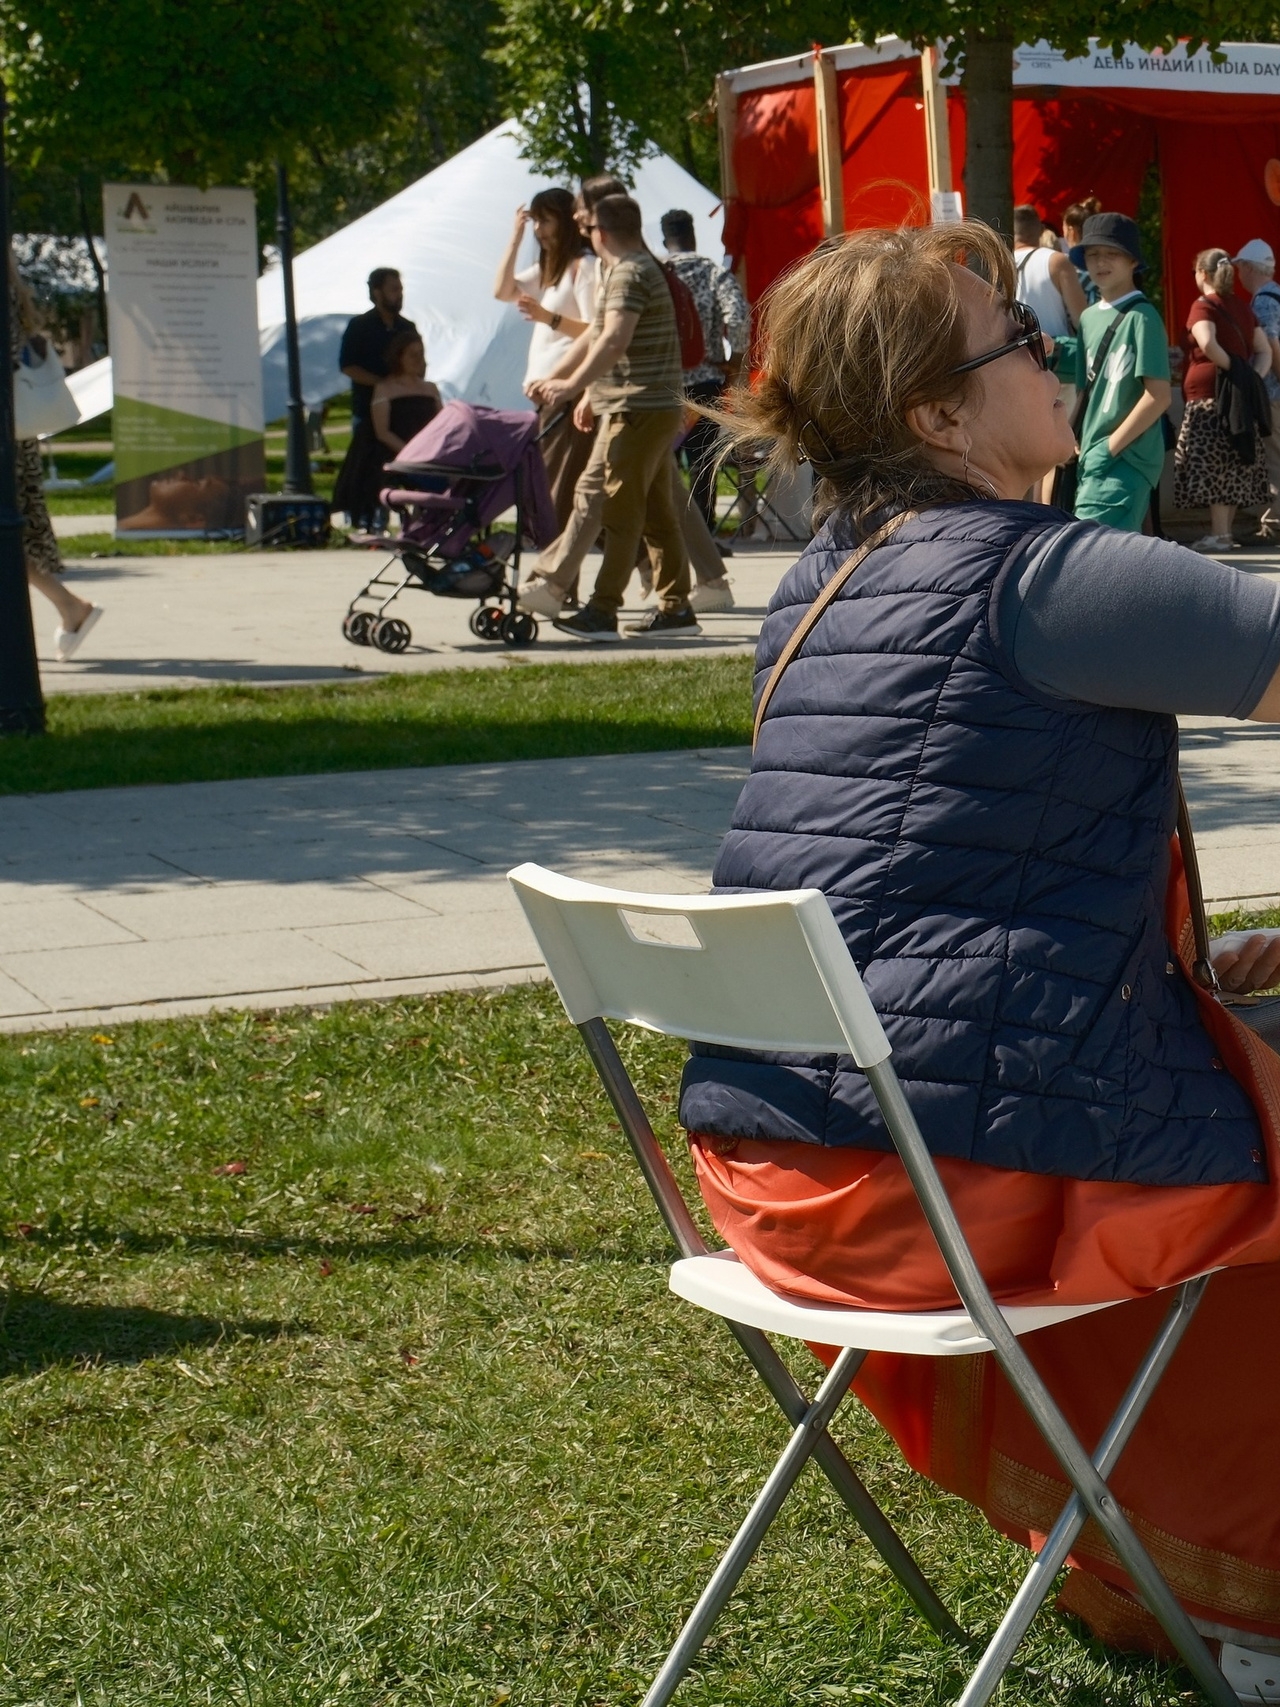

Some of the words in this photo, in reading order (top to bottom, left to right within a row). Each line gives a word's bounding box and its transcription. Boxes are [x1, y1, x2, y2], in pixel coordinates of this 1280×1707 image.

[1093, 56, 1135, 70] ДЕНЬ
[1138, 58, 1195, 73] ИНДИИ
[1207, 61, 1250, 75] INDIA
